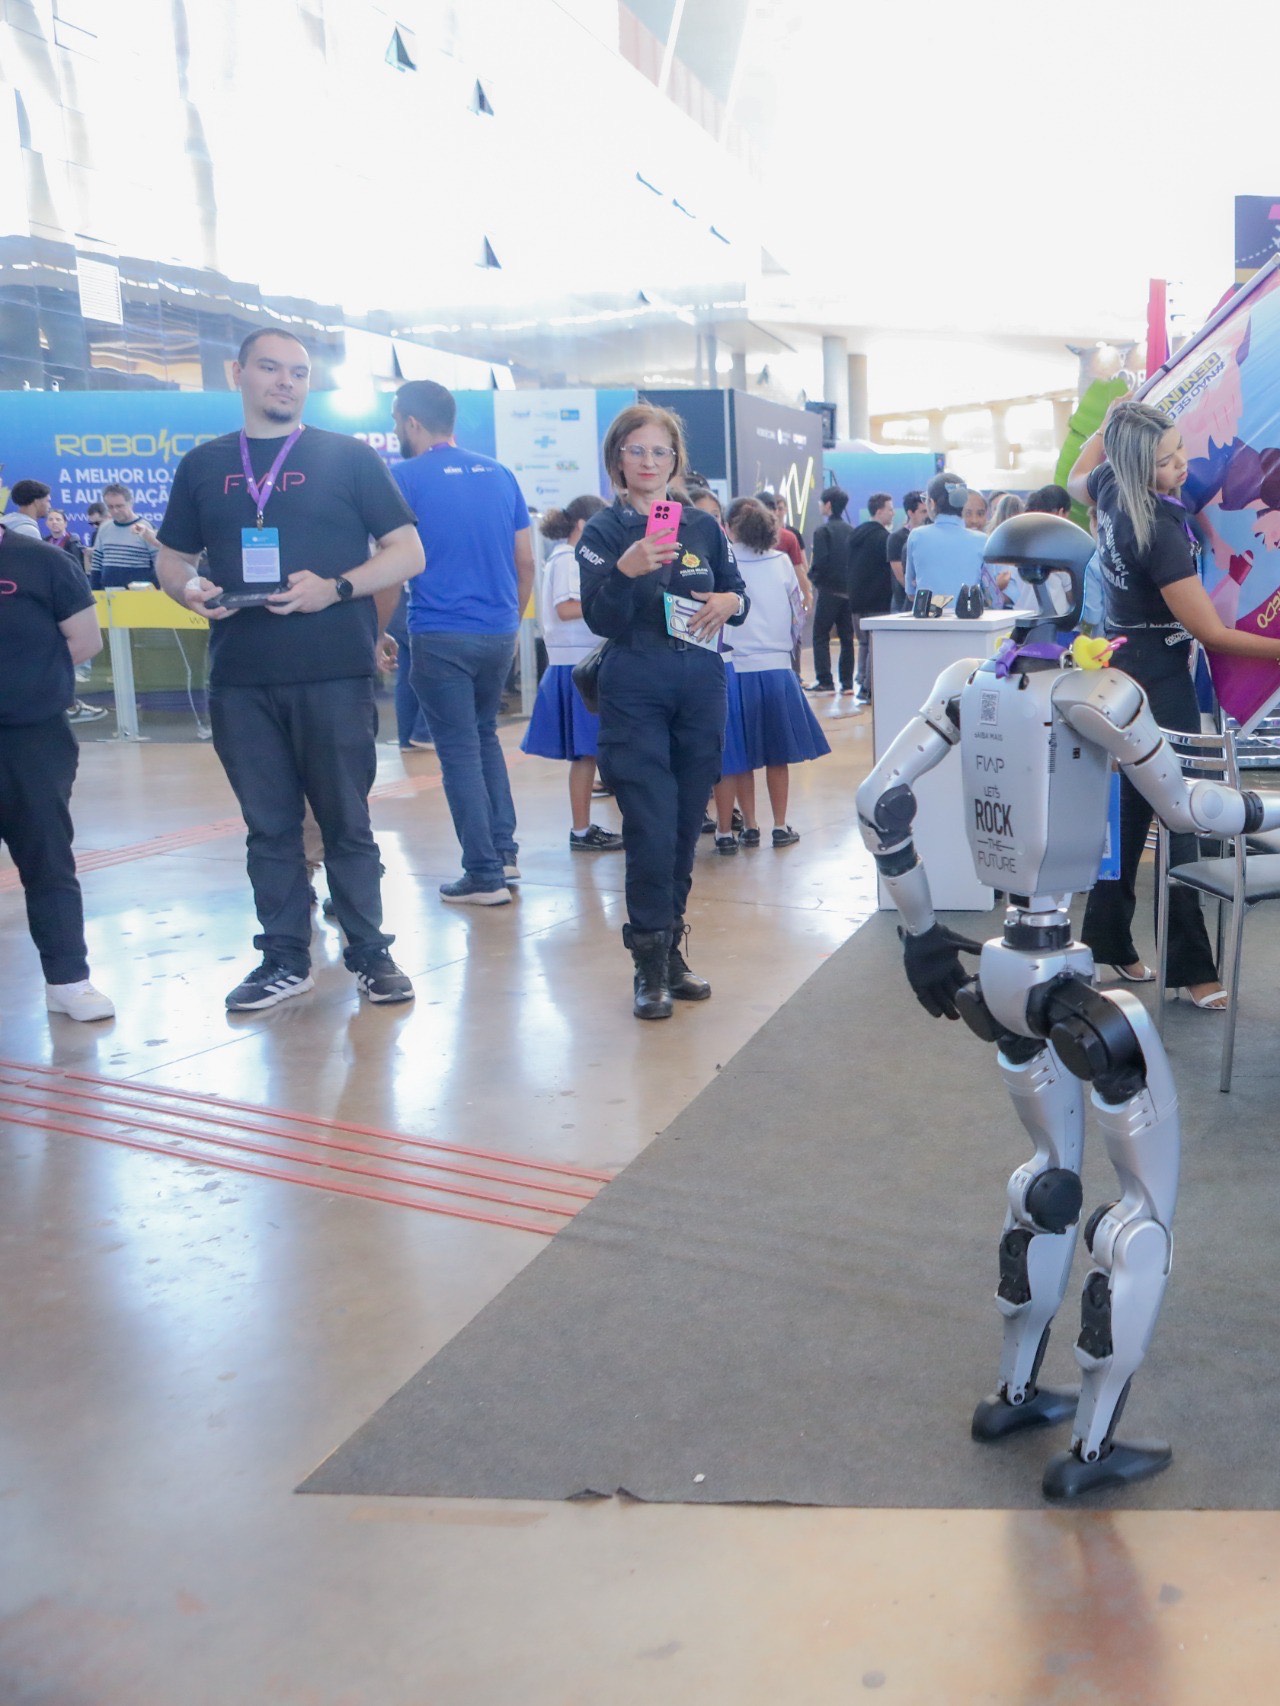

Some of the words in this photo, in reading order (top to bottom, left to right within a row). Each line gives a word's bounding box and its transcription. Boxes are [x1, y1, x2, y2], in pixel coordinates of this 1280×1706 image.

[59, 469, 72, 484] A
[75, 469, 143, 485] MELHOR
[61, 490, 72, 503] E
[579, 545, 605, 566] PMDF
[975, 799, 1014, 837] ROCK
[978, 851, 1016, 873] FUTURE
